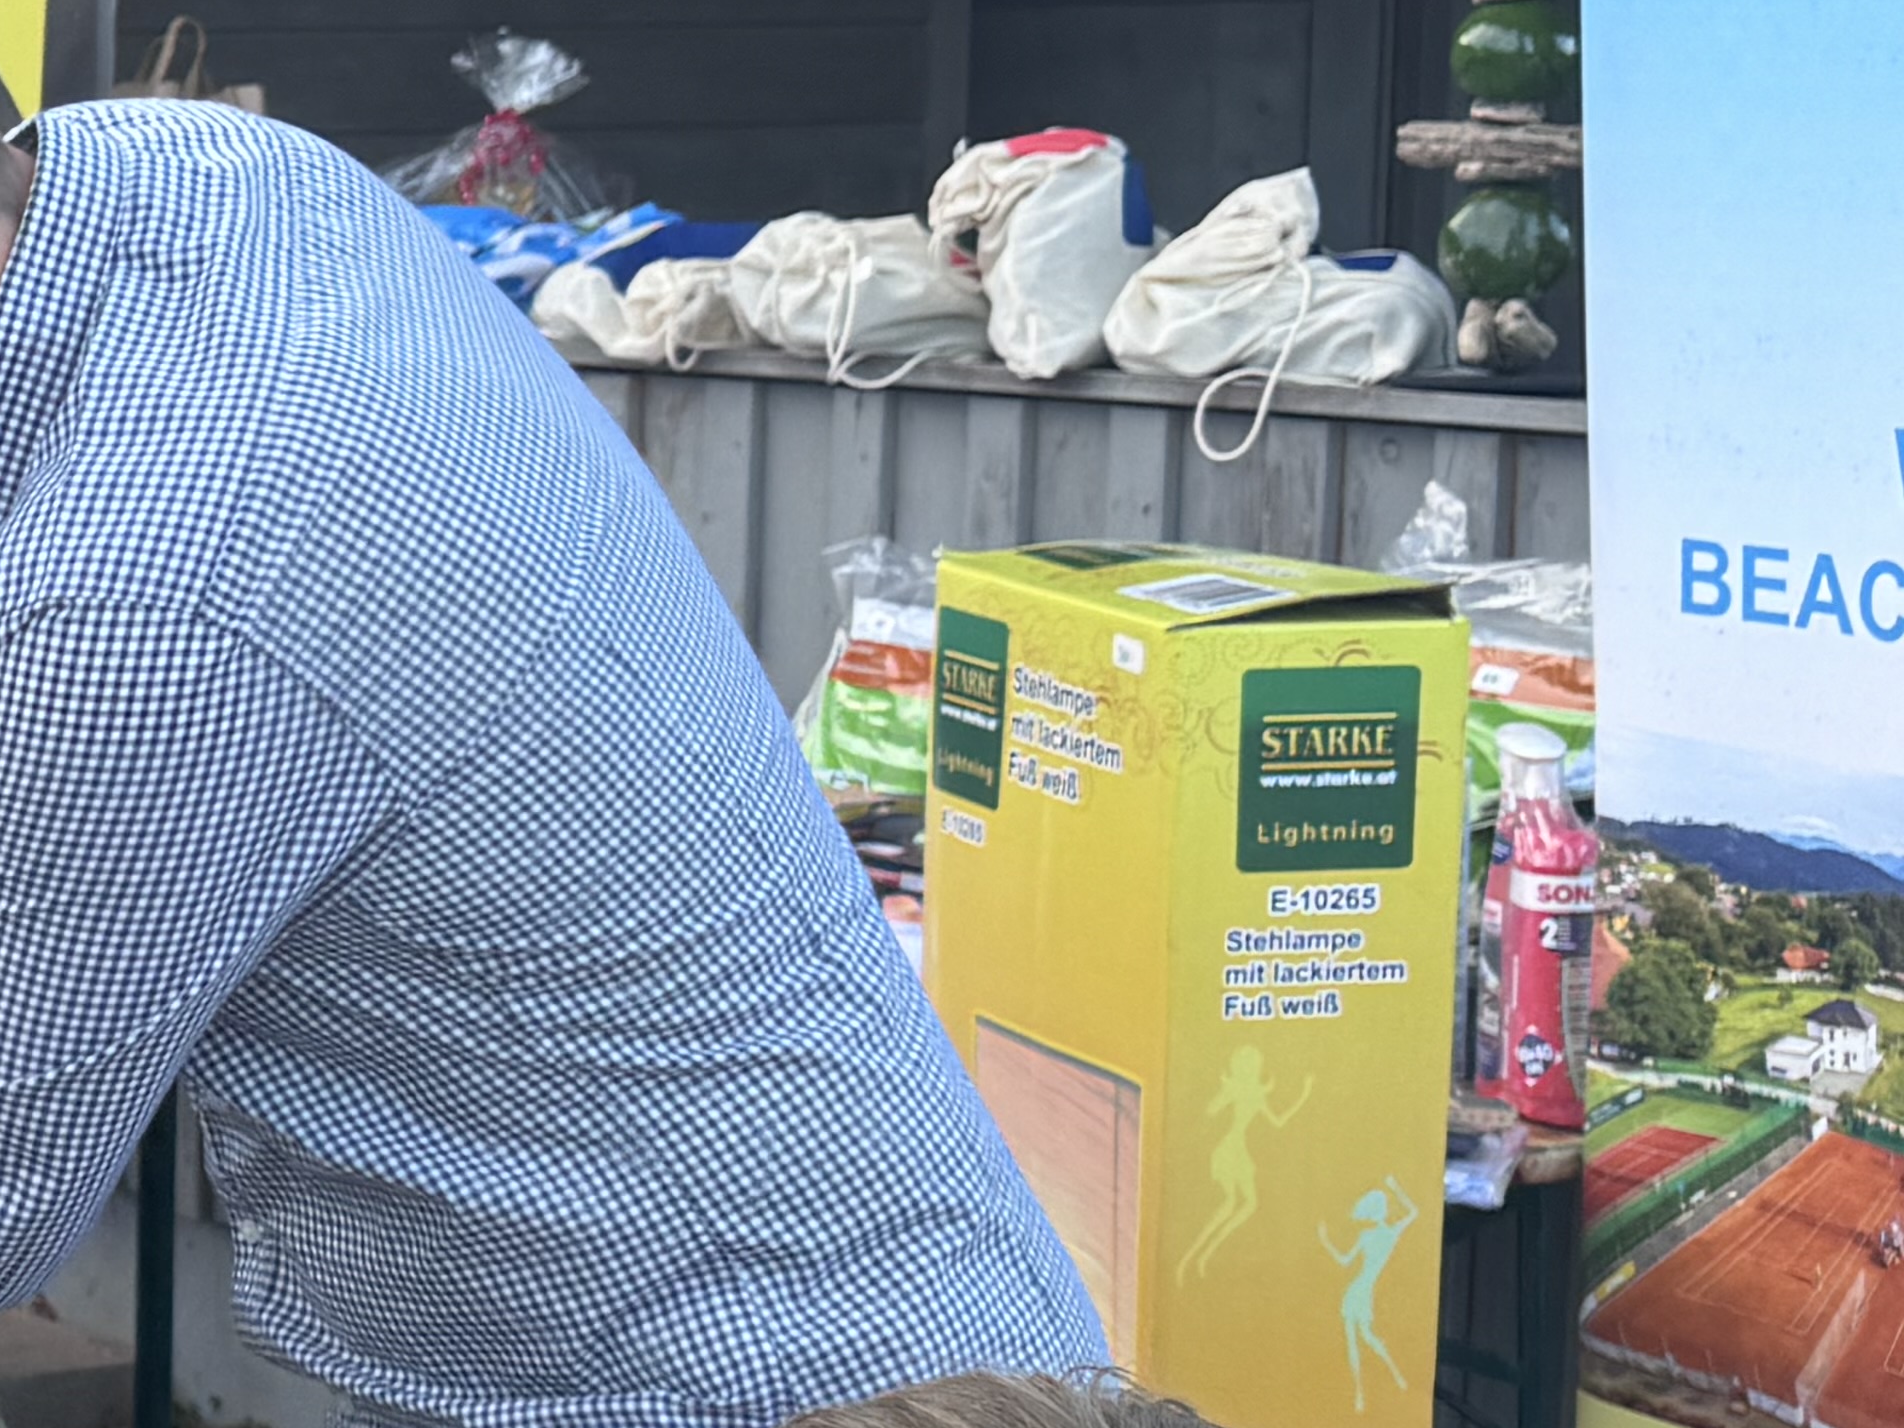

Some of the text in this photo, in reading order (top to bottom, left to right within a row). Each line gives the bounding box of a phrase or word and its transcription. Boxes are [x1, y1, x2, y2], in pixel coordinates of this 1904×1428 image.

[1681, 538, 1904, 642] BEAC
[943, 661, 997, 702] STARKE
[1013, 666, 1095, 718] Stehlampe
[1040, 723, 1123, 771] lackiertem
[1261, 724, 1394, 759] STARKE
[1042, 765, 1079, 802] weiß
[1260, 770, 1398, 789] www.starke.at
[1257, 820, 1395, 848] Lightning
[1271, 887, 1377, 913] E-10265
[1537, 882, 1595, 905] SON
[1226, 928, 1362, 955] Stehlampe
[1225, 959, 1405, 985] mit lackiertem
[1224, 992, 1339, 1017] Fuß weiß
